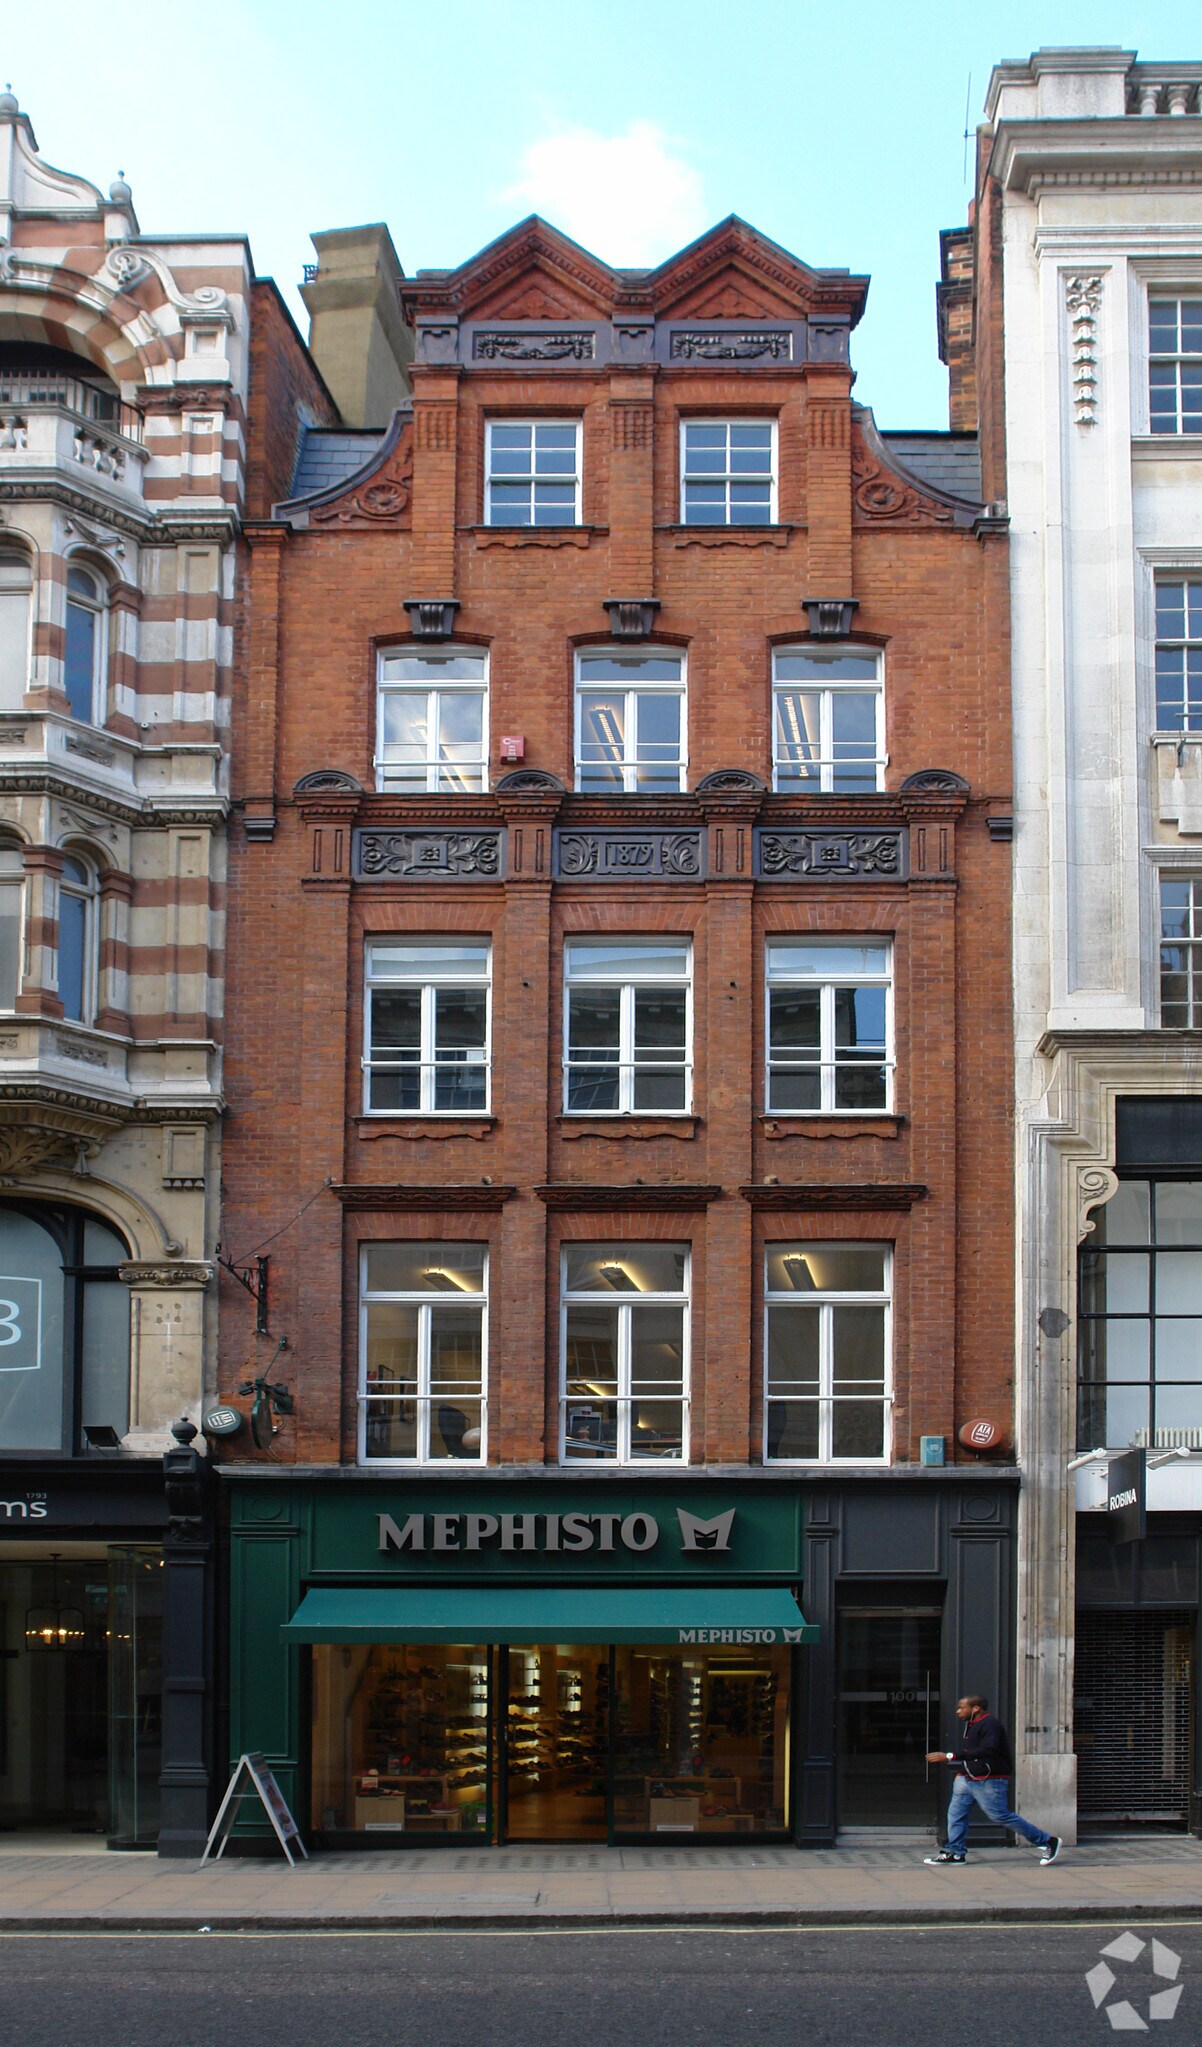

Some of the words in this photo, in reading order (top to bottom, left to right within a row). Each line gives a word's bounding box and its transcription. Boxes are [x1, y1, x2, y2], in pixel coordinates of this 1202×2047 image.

[607, 845, 653, 866] 1879
[1109, 1488, 1137, 1511] ROBINA
[375, 1511, 659, 1551] MEPHISTO
[678, 1629, 777, 1643] MEPHISTO
[889, 1691, 915, 1704] 100
